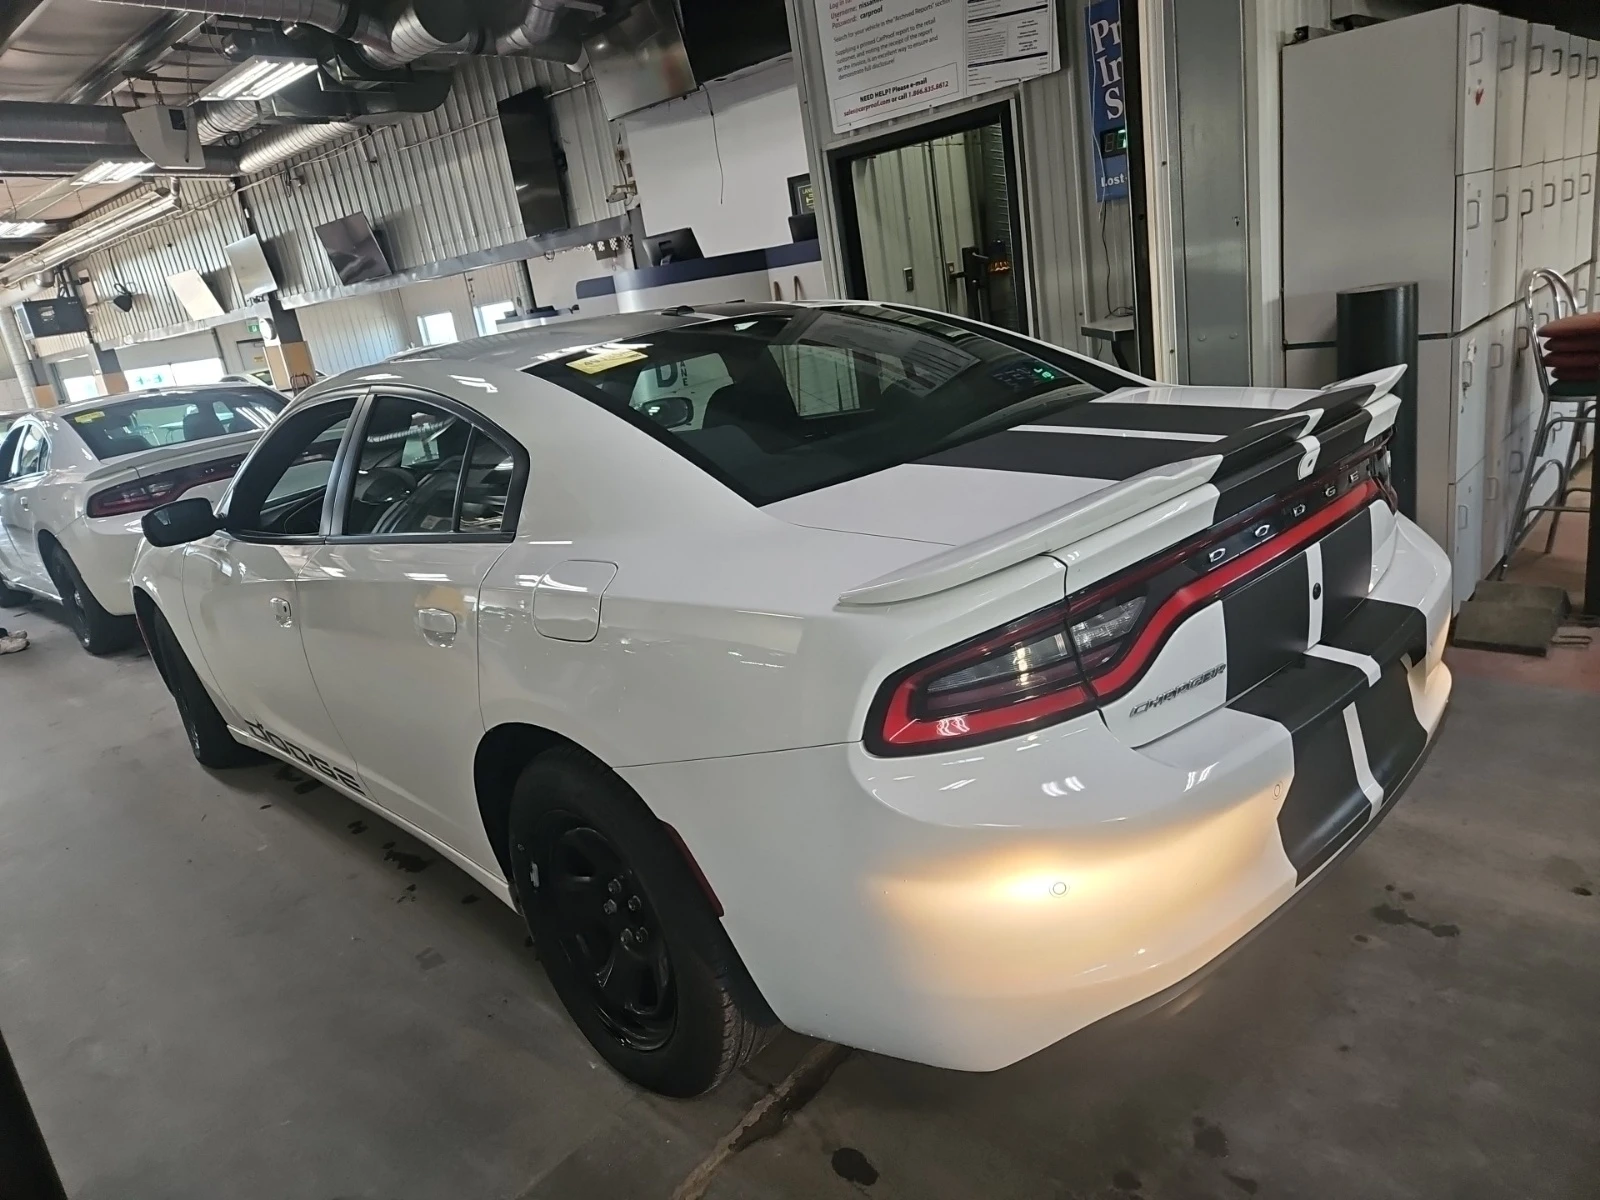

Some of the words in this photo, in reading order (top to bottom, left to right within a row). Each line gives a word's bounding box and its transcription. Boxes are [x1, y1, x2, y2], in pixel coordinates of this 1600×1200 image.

[831, 16, 856, 29] Password:
[859, 5, 883, 19] carproof
[833, 34, 847, 42] Search
[854, 28, 864, 36] your
[864, 21, 880, 32] vehicle
[835, 45, 856, 56] Supplying
[859, 38, 875, 48] printed
[875, 31, 894, 42] CarProof
[895, 27, 909, 36] report
[923, 16, 935, 26] retail
[865, 46, 879, 55] noting
[888, 38, 903, 47] receipt
[918, 28, 932, 37] report
[877, 48, 896, 59] excellent
[897, 46, 906, 54] way
[912, 39, 928, 47] ensure
[838, 67, 864, 80] demonstrate
[859, 93, 874, 102] NEED
[874, 87, 891, 98] HELP?
[892, 82, 909, 93] Please
[909, 77, 927, 87] e-mail
[898, 92, 907, 100] call
[1209, 471, 1359, 563] DODGE
[1129, 663, 1227, 718] CHARGER
[245, 719, 367, 796] DODGE
